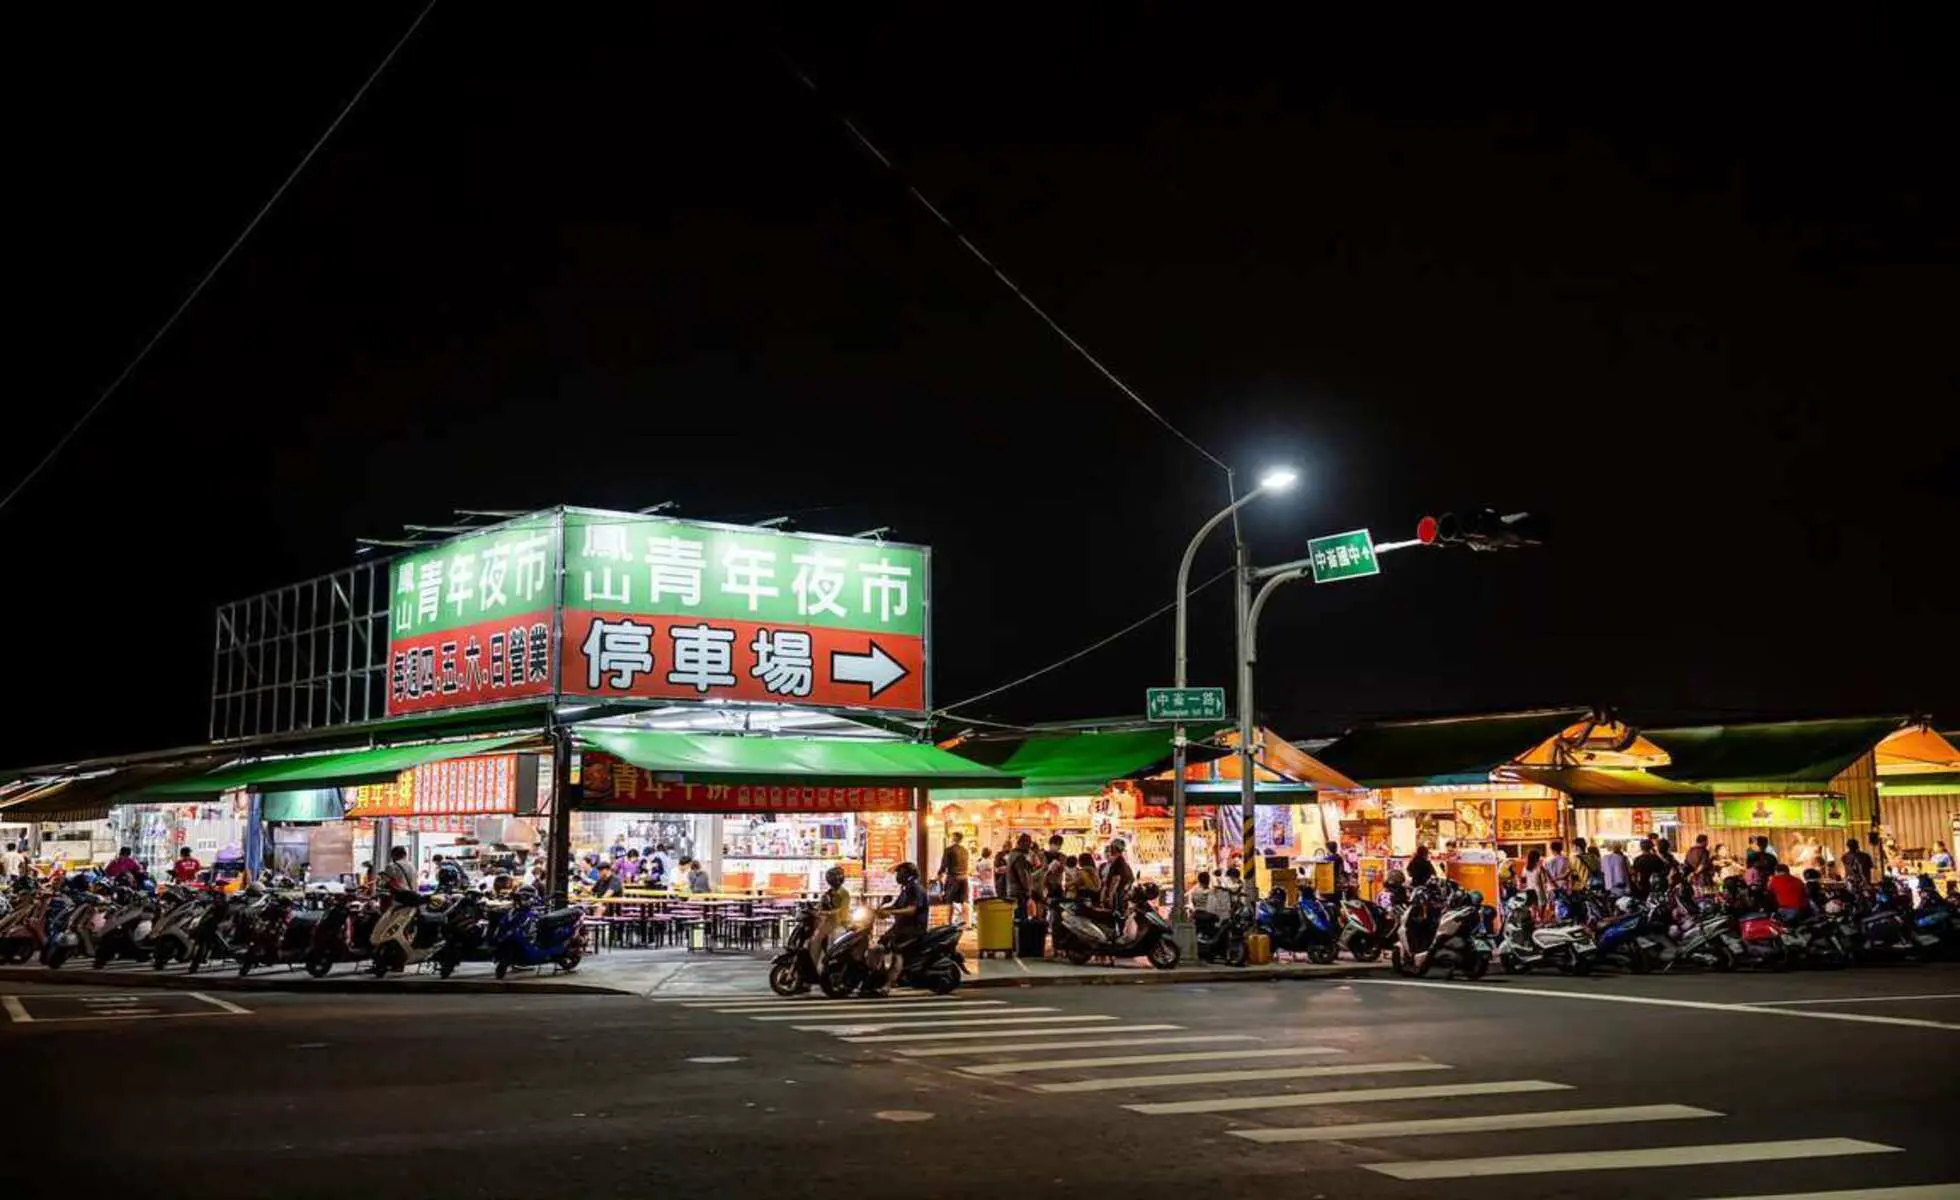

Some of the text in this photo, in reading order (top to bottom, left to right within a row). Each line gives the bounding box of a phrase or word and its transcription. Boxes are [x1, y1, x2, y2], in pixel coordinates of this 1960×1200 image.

[417, 532, 549, 624] 青年夜市
[643, 534, 912, 623] 青年夜市
[582, 619, 815, 698] 停車場
